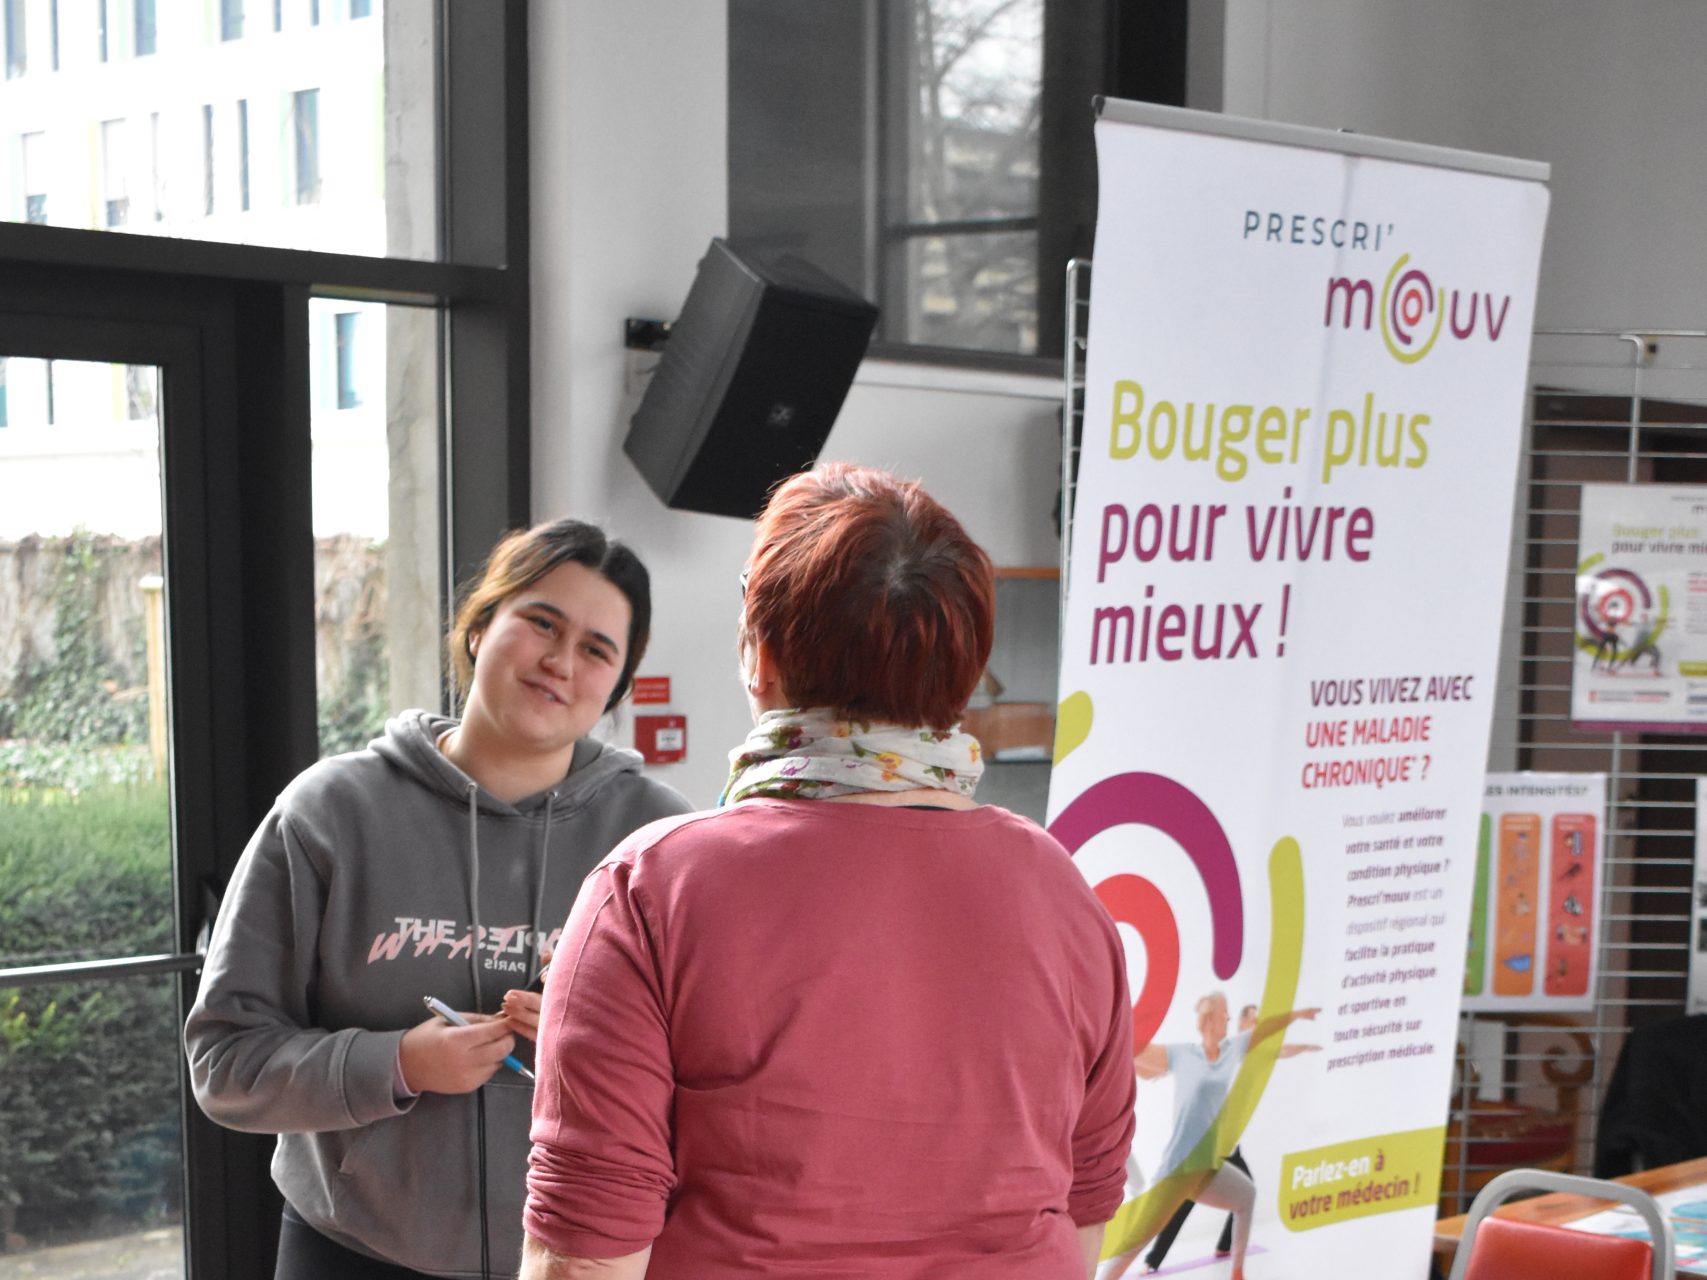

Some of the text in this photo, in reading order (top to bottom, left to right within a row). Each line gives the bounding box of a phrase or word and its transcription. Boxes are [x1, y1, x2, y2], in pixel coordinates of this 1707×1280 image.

[1243, 210, 1396, 251] PRESCRI'
[1108, 379, 1431, 483] Bouger plus
[1097, 486, 1376, 583] pour vivre
[1090, 584, 1291, 666] mieux !
[1310, 675, 1474, 707] VOUS VIVEZ AVEC
[1305, 715, 1432, 748] UNE MALADIE
[1420, 754, 1432, 781] ?
[1343, 814, 1364, 828] Vous
[1397, 807, 1448, 823] améliorer
[1345, 835, 1444, 855] votre santé et votre
[1347, 864, 1392, 881] condition
[1393, 861, 1442, 880] physique
[1346, 891, 1411, 908] Prescri'mouv
[1412, 888, 1429, 901] est
[1390, 914, 1428, 932] régional
[1344, 940, 1436, 961] facilite la pratique
[1341, 966, 1437, 989] d'activité physique
[1337, 995, 1406, 1016] et sportive en
[1333, 1018, 1422, 1043] toute sécurité sur
[1326, 1049, 1385, 1073] prescription
[1290, 1147, 1385, 1191] Parlez-en à
[1288, 1171, 1421, 1221] votre médecin !
